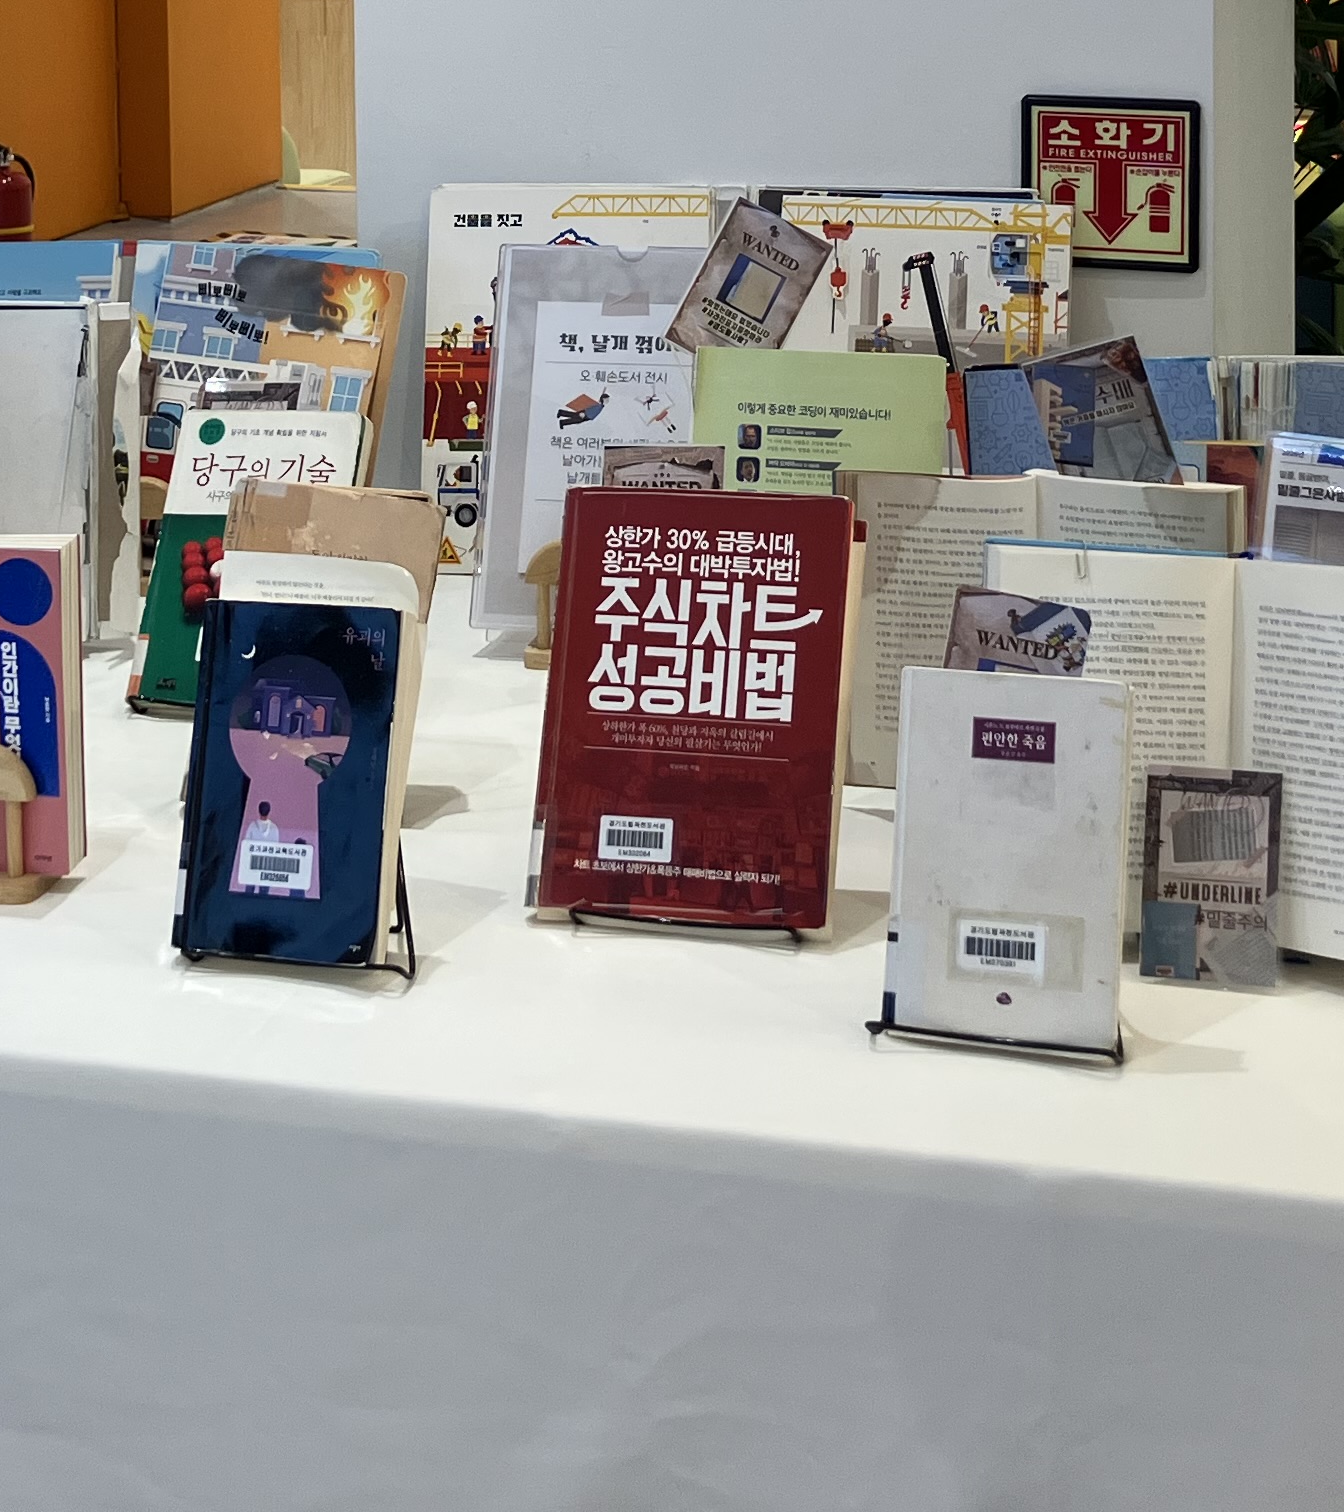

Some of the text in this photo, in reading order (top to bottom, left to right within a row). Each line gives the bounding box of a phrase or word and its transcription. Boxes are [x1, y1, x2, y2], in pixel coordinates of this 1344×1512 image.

[1048, 148, 1173, 162] FIRE EXTINGUISHER
[496, 213, 523, 228] 짓고
[743, 232, 799, 271] WANTED
[559, 333, 629, 353] 책, 날개
[644, 369, 668, 385] 전시
[738, 402, 892, 421] 이렇게 중요한 코딩이 재미있습니다!
[550, 437, 573, 450] 책은
[192, 452, 337, 487] 당구의 기술
[562, 454, 602, 468] 날아가
[567, 472, 601, 485] 날개를
[605, 525, 801, 557] 상한가 30% 급등시대,
[602, 549, 800, 582] 왕고수의 대박투자법!
[595, 576, 816, 652] 주식차트
[342, 626, 386, 648] 유괴의
[976, 629, 1058, 660] WANTED
[587, 643, 796, 722] 성공비법
[981, 730, 1047, 750] 편안한 죽음
[1163, 881, 1262, 905] #UNDERLINE
